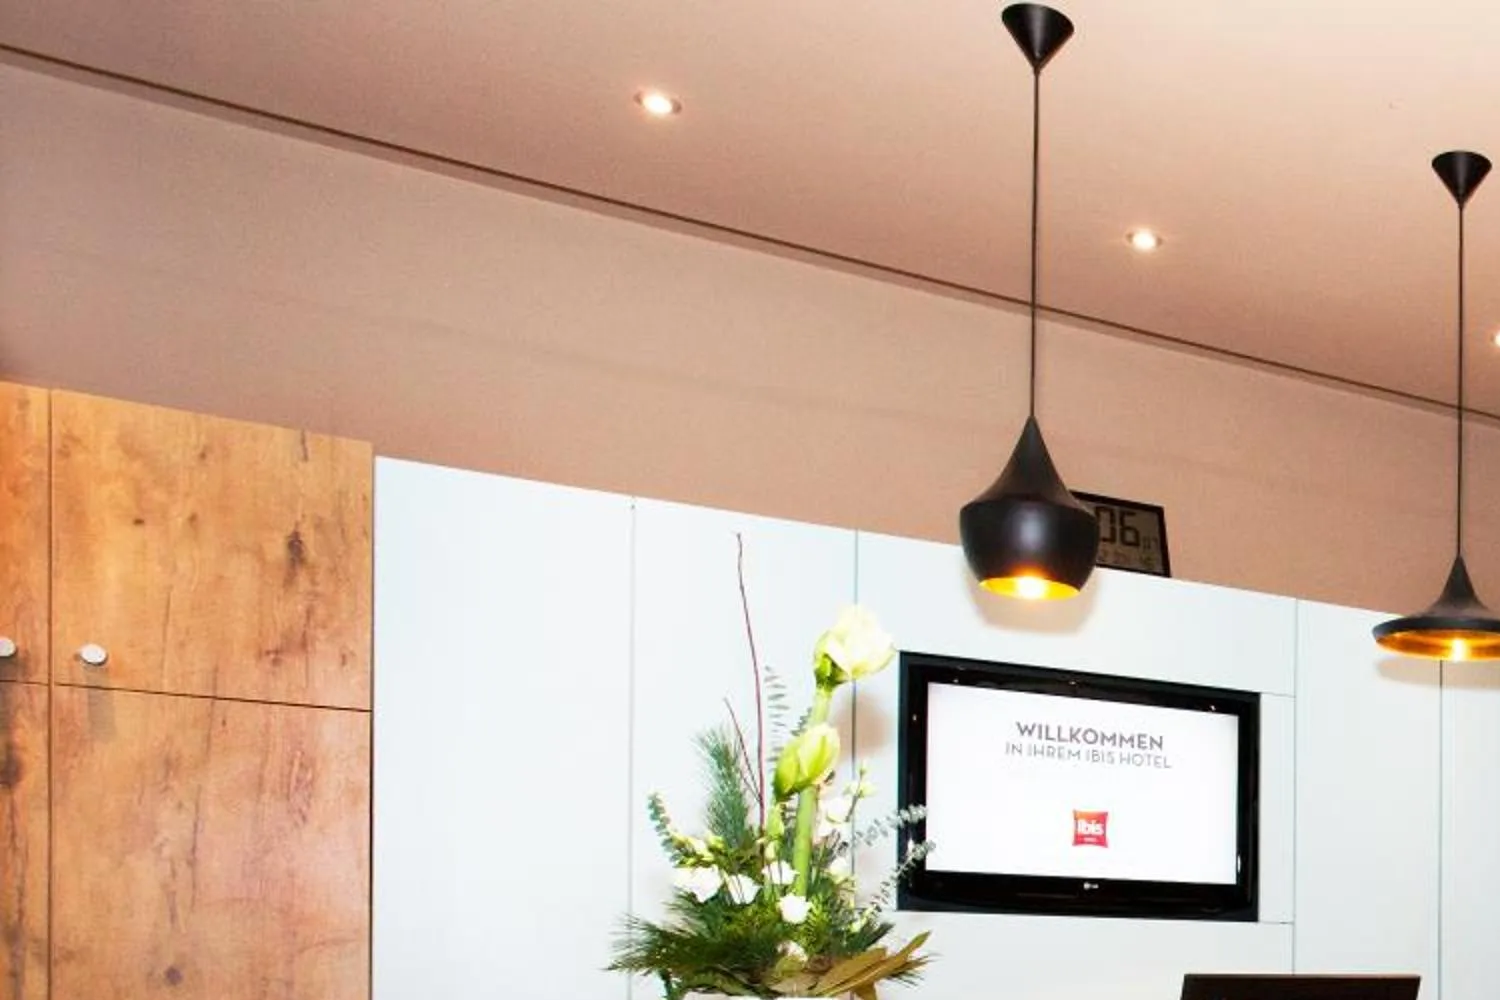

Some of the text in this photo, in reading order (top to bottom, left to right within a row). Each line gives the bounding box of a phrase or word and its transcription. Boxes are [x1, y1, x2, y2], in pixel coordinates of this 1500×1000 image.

[1015, 721, 1164, 751] WILLKOMMEN
[1005, 742, 1173, 769] IN IHREM IBIS HOTEL
